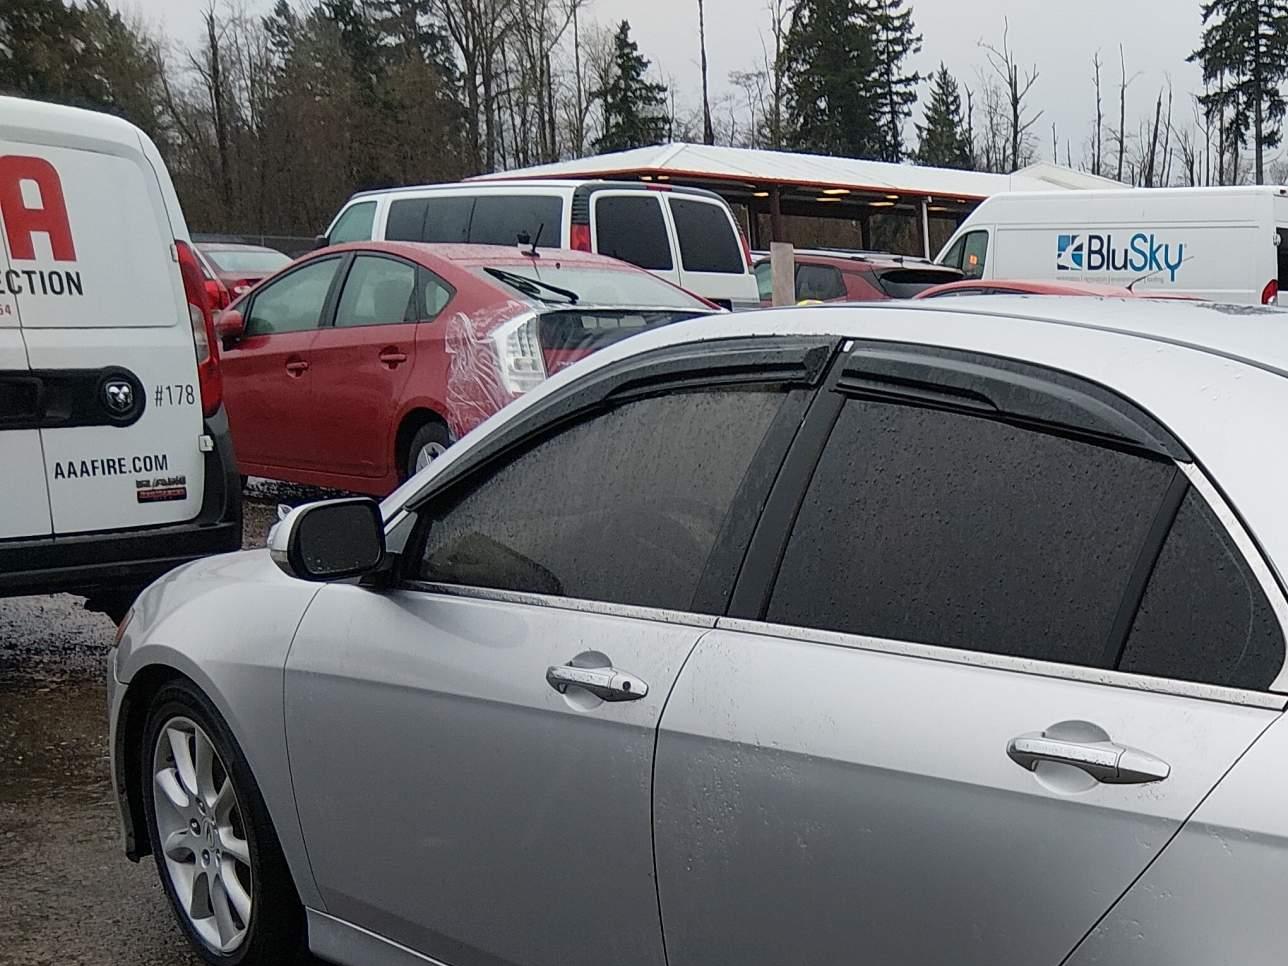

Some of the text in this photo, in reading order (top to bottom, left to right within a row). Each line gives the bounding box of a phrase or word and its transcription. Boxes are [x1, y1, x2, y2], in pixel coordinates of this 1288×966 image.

[1087, 233, 1184, 282] BluSky
[154, 384, 196, 407] #178
[54, 453, 169, 480] AAAFIRE.COM
